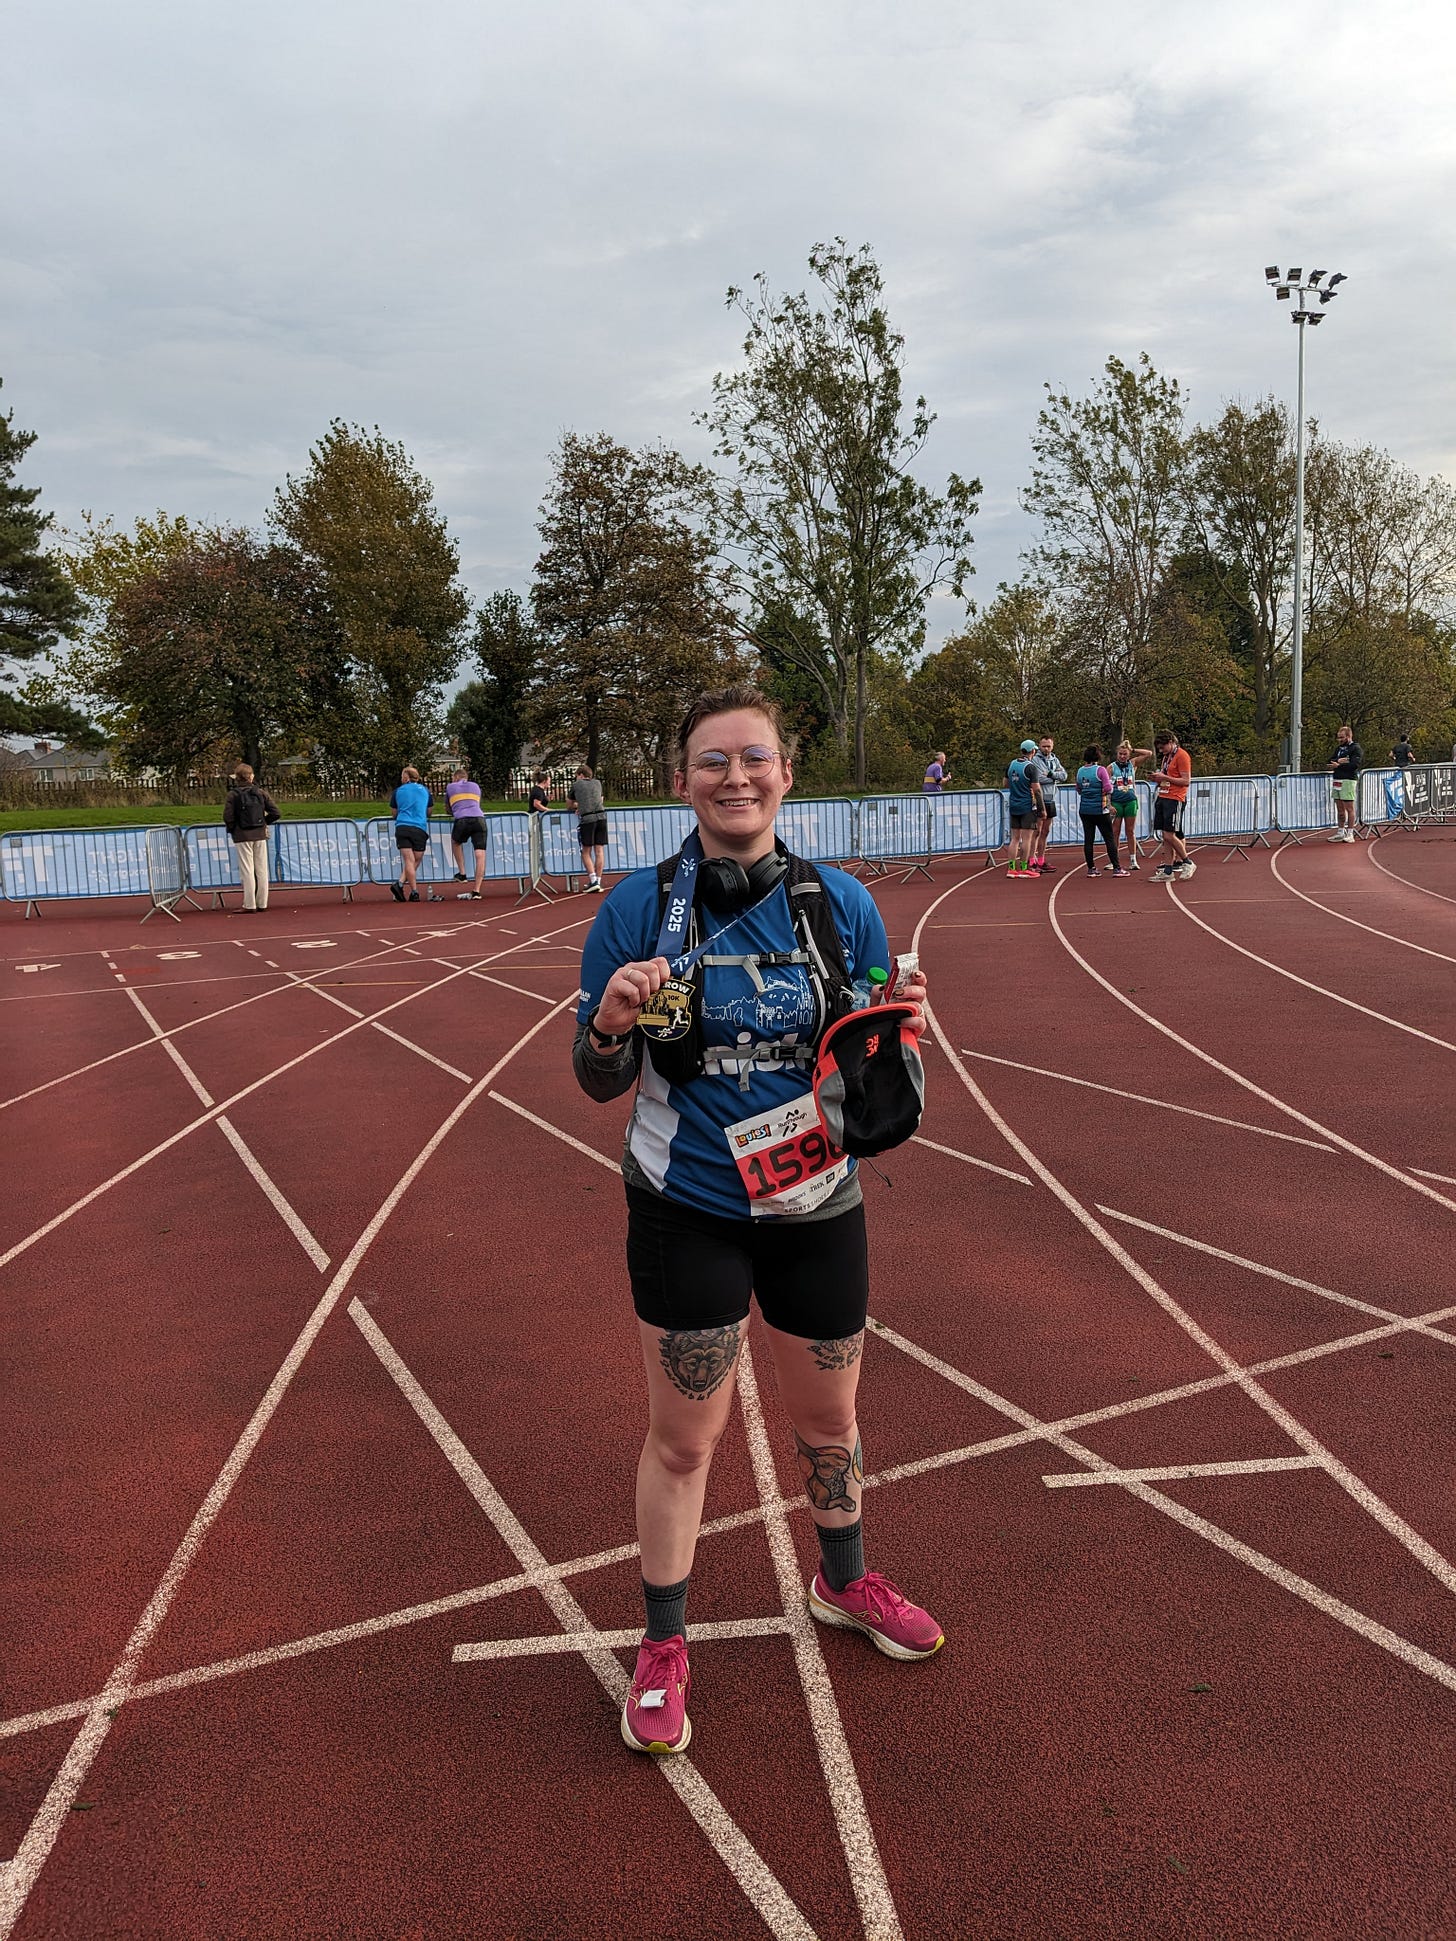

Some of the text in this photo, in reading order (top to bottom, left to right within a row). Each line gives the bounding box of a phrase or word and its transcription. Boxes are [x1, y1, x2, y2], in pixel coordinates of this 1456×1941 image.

[667, 897, 687, 933] 2025
[663, 981, 690, 994] ROW
[667, 994, 680, 1002] 10K
